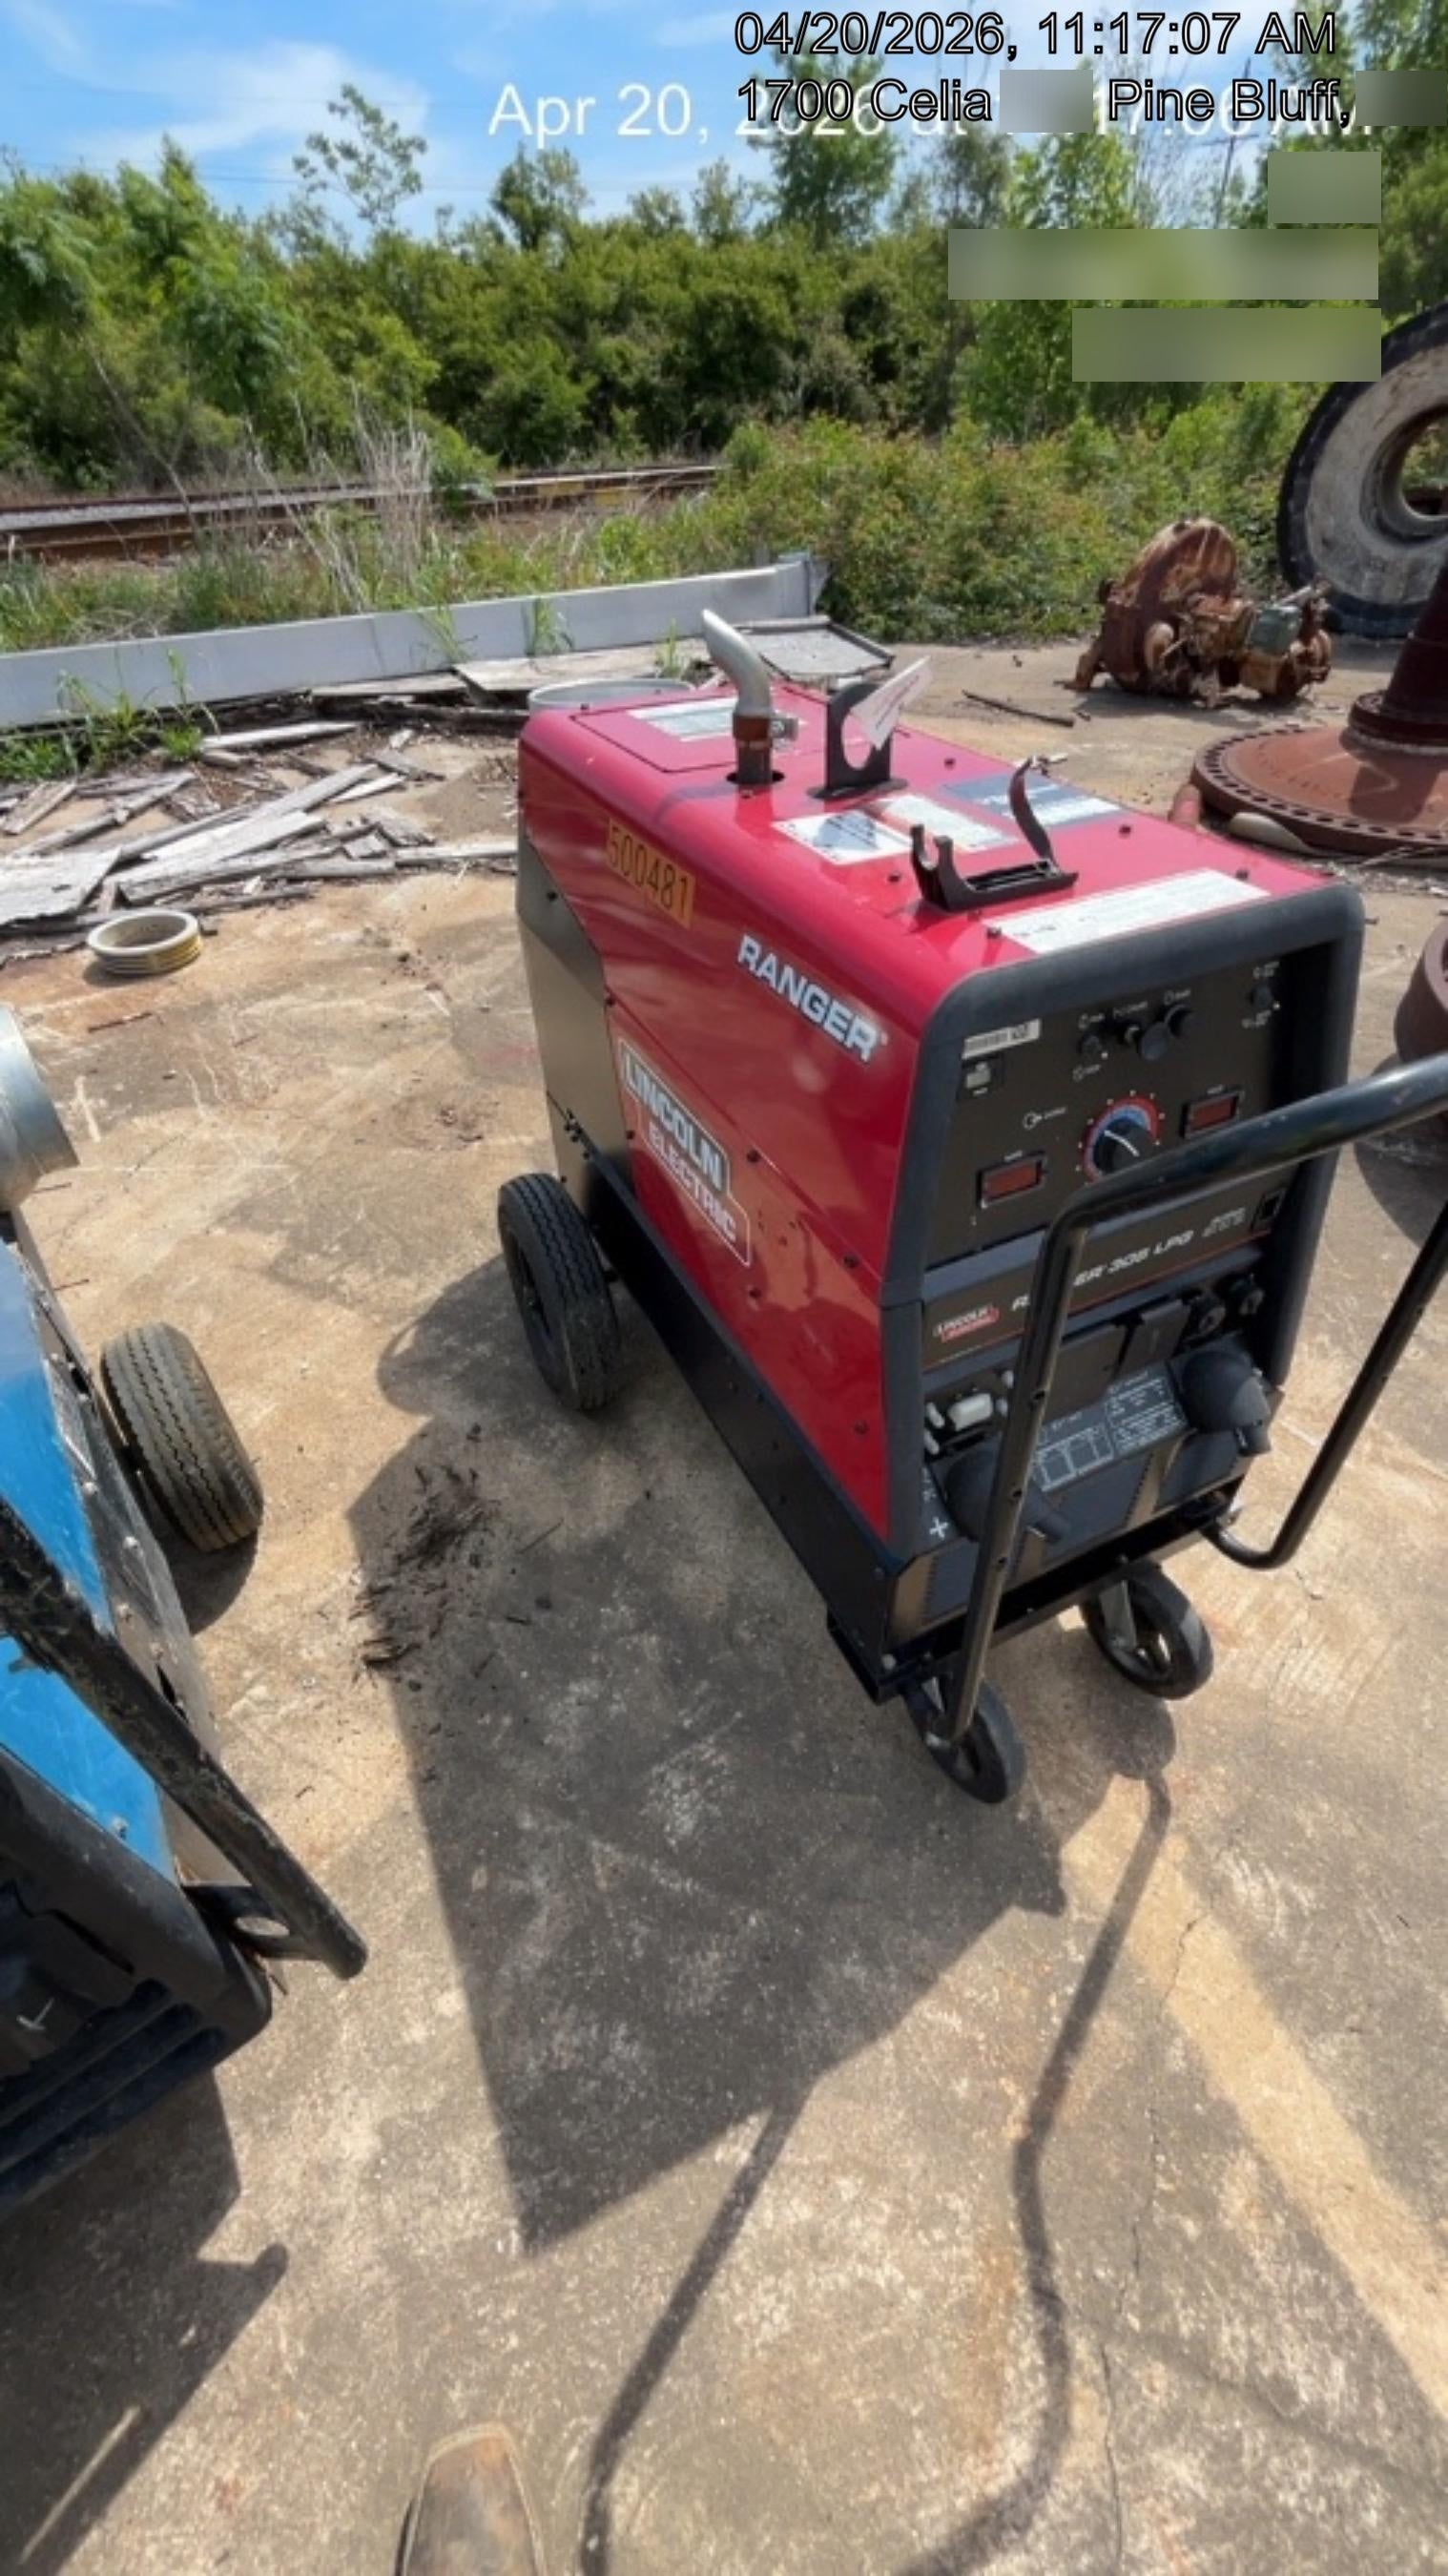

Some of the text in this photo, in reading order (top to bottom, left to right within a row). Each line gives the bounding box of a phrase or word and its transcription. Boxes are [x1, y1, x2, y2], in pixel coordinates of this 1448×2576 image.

[609, 821, 691, 919] 500481
[737, 933, 878, 1063] RANGER
[626, 1052, 724, 1192] LINCOLN
